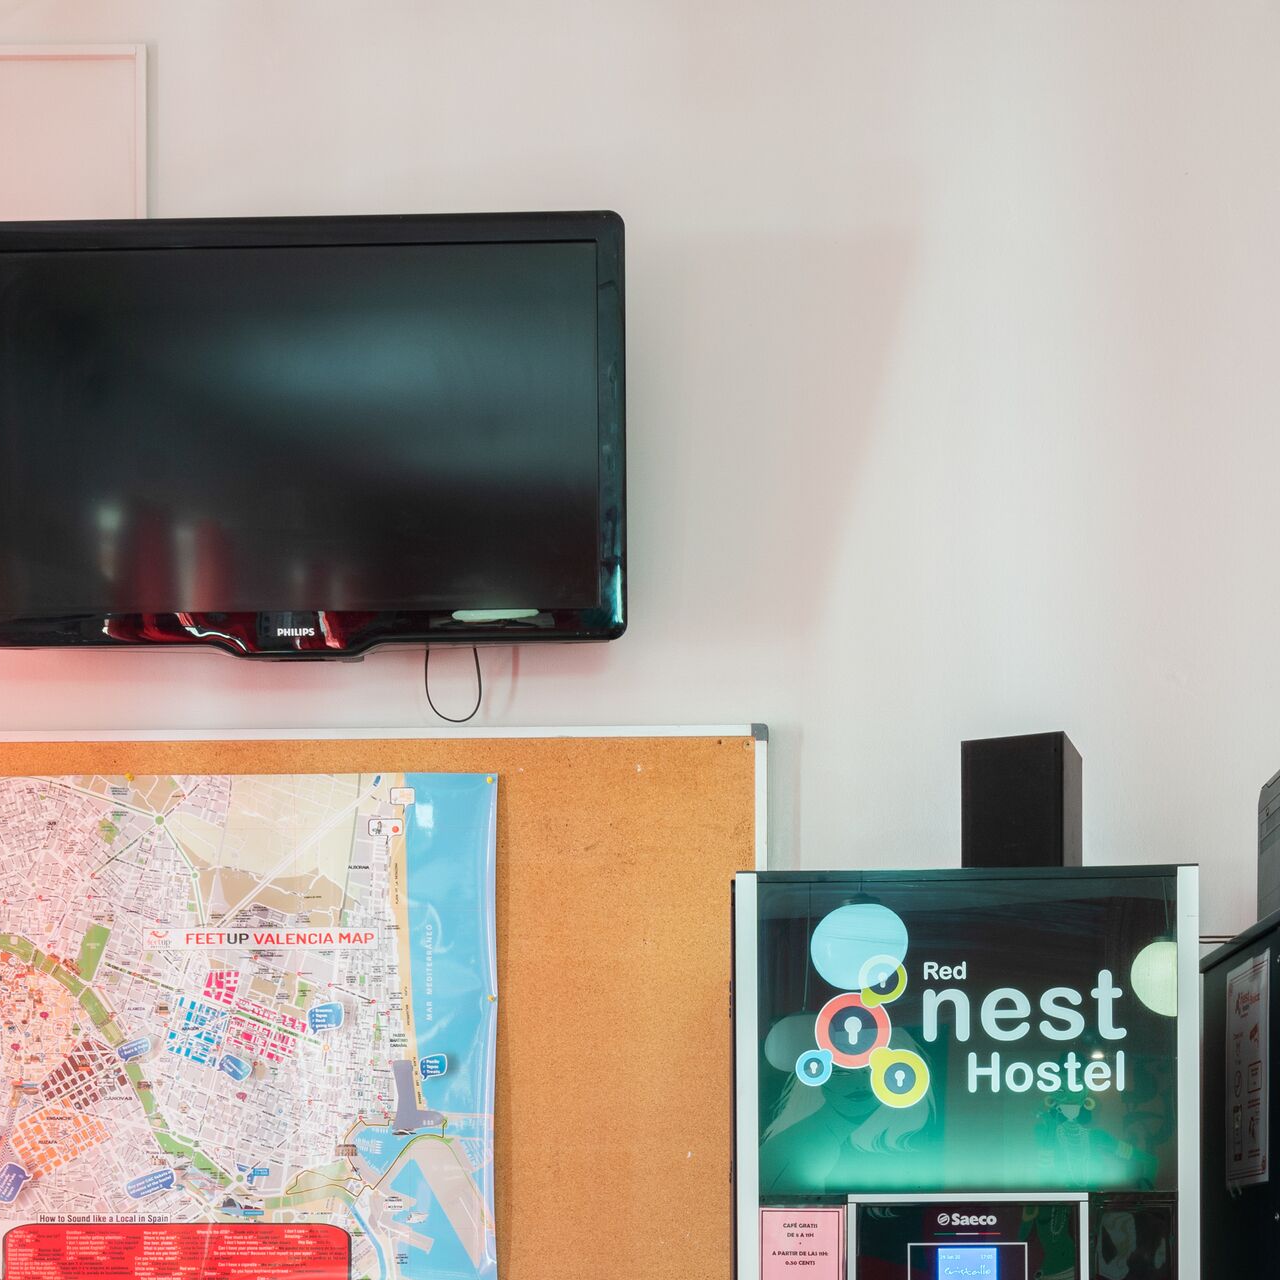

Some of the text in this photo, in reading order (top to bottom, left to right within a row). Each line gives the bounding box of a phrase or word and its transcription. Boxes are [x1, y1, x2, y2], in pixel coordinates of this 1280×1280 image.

[277, 628, 315, 637] PHILIPS
[186, 933, 374, 945] FEETUP VALENCIA MAP
[924, 962, 967, 980] Red
[923, 969, 1127, 1043] nest
[968, 1050, 1125, 1093] Hostel
[40, 1215, 56, 1223] How
[58, 1215, 65, 1223] to
[67, 1215, 91, 1223] Sound
[93, 1215, 106, 1223] like
[116, 1215, 137, 1223] Local
[138, 1215, 145, 1223] in
[148, 1215, 169, 1224] Spain
[951, 1213, 997, 1226] Saeco
